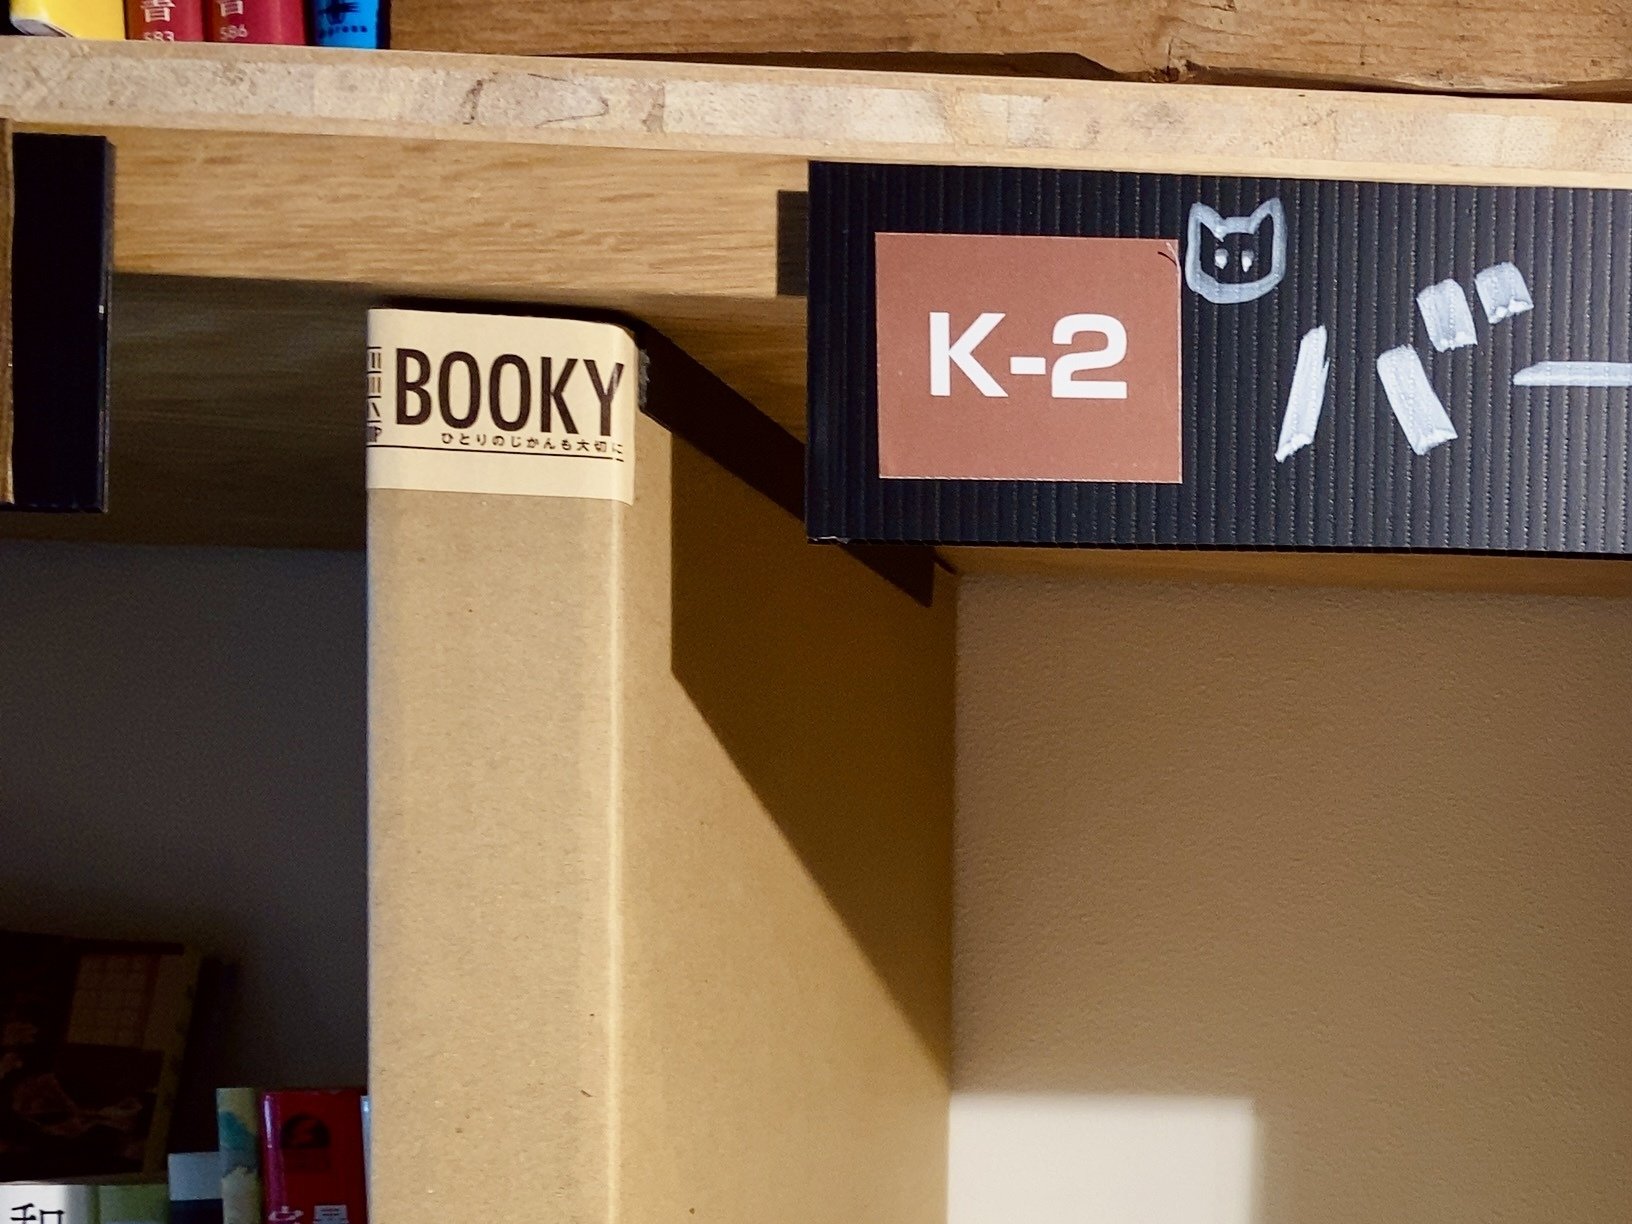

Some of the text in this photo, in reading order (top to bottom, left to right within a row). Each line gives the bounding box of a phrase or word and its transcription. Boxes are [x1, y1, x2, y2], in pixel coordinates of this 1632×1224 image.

[394, 346, 625, 438] BOOKY
[928, 312, 1130, 399] K-2
[441, 431, 625, 455] ひとりのじかんも大切に
